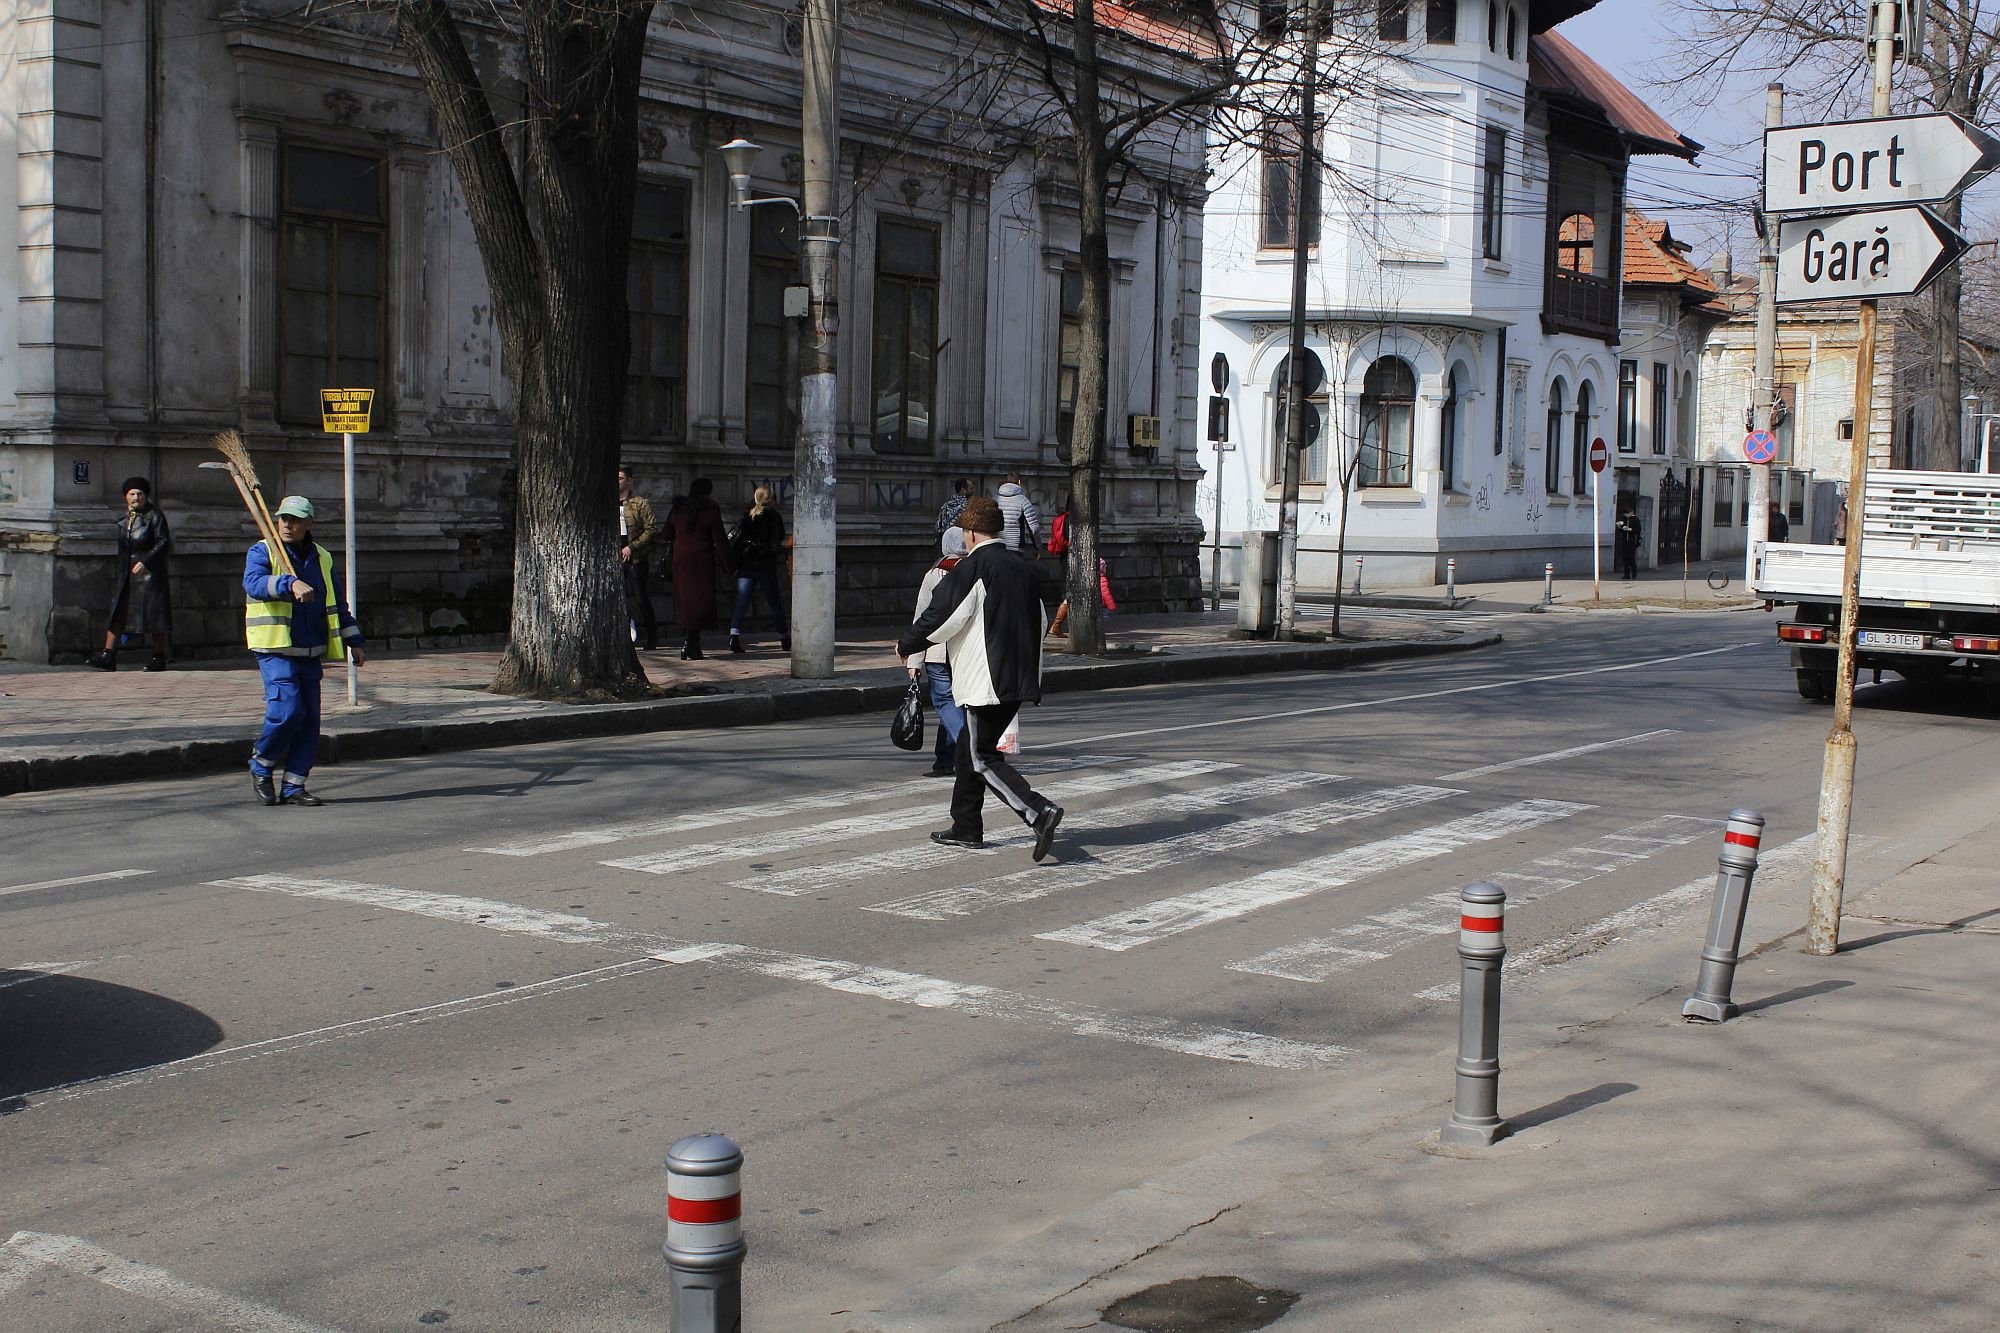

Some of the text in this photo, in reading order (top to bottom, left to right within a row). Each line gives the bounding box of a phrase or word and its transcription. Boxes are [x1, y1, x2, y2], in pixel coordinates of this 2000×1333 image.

[1799, 135, 1905, 195] Port
[1803, 225, 1890, 284] Gară
[1866, 632, 1920, 646] GL 33 TER
